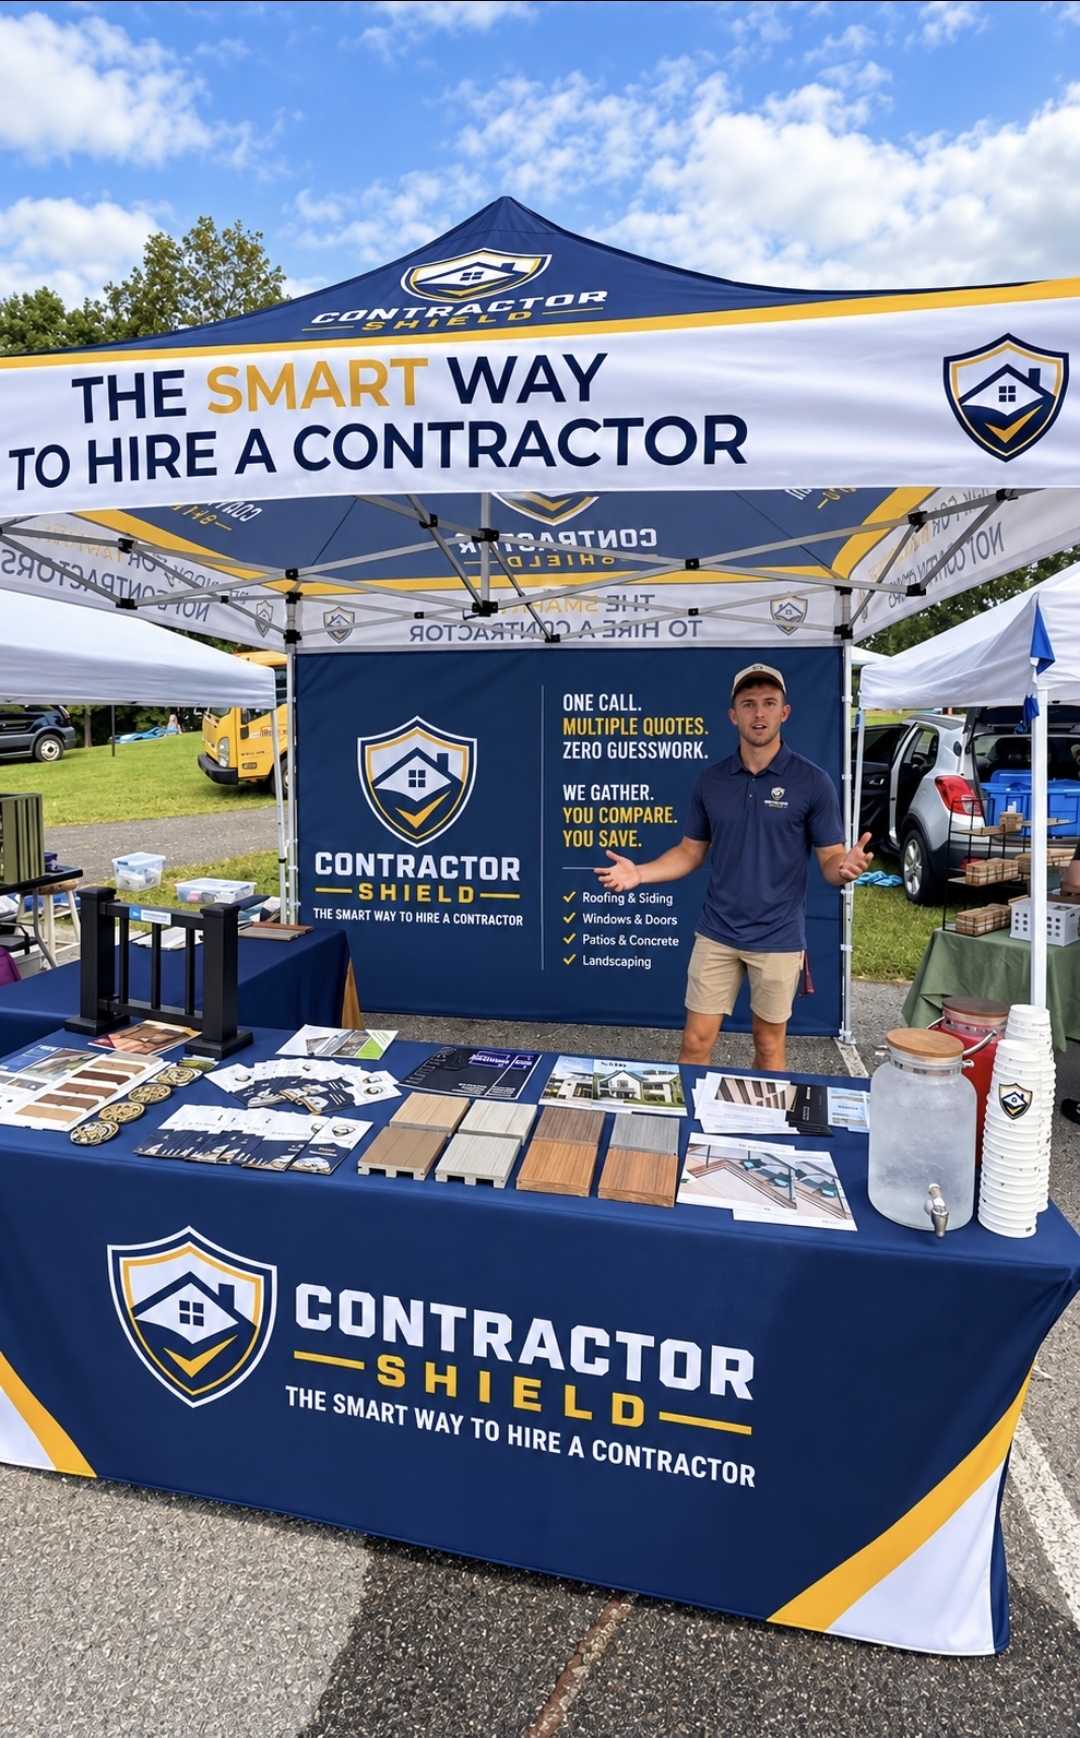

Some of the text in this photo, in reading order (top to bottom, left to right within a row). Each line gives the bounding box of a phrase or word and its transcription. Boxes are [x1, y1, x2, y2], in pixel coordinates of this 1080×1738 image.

[311, 290, 608, 324] CONTRACTOR
[361, 311, 532, 331] SHIELD
[71, 352, 609, 424] THE SMART WAY
[9, 414, 748, 491] TO HIRE A CONTRACTOR
[563, 693, 642, 711] ONE CALL.
[563, 717, 709, 736] MULTIPLE QUOTES.
[563, 741, 709, 759] ZERO GUESSWORK.
[563, 784, 654, 801] WE GATHER.
[563, 806, 678, 823] YOU COMPARE.
[563, 830, 642, 847] YOU SAVE.
[315, 851, 521, 881] CONTRACTOR
[358, 882, 474, 904] SHIELD
[582, 892, 673, 906] Roofing & Siding
[313, 907, 523, 926] THE SMART WAY TO HIRE A CONTRACTOR
[582, 913, 678, 925] Windows & Doors
[582, 934, 679, 946] Patios & Concrete
[582, 955, 651, 969] Landscaping
[295, 1282, 754, 1401] CONTRACTOR
[376, 1354, 645, 1428] SHIELD
[285, 1385, 756, 1488] THE SMART WAY TO HIRE A CONTRACTOR
